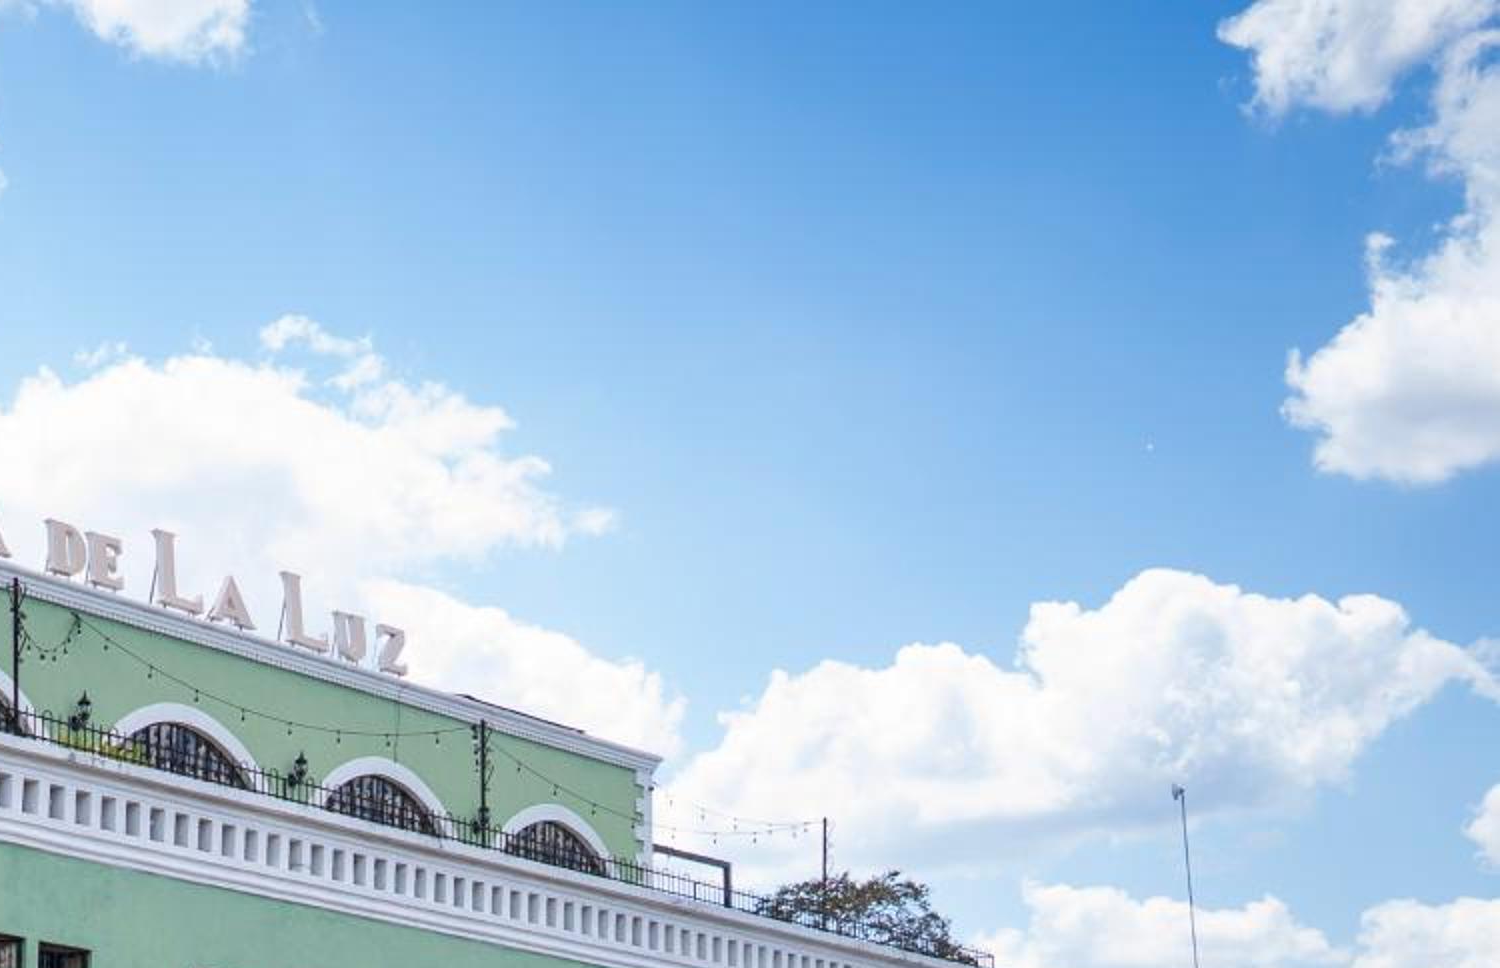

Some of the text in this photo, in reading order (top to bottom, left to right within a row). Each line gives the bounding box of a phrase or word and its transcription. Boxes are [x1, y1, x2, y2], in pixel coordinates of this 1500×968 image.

[44, 517, 126, 591] DE
[151, 528, 258, 631] LA
[278, 570, 409, 676] LUZ
